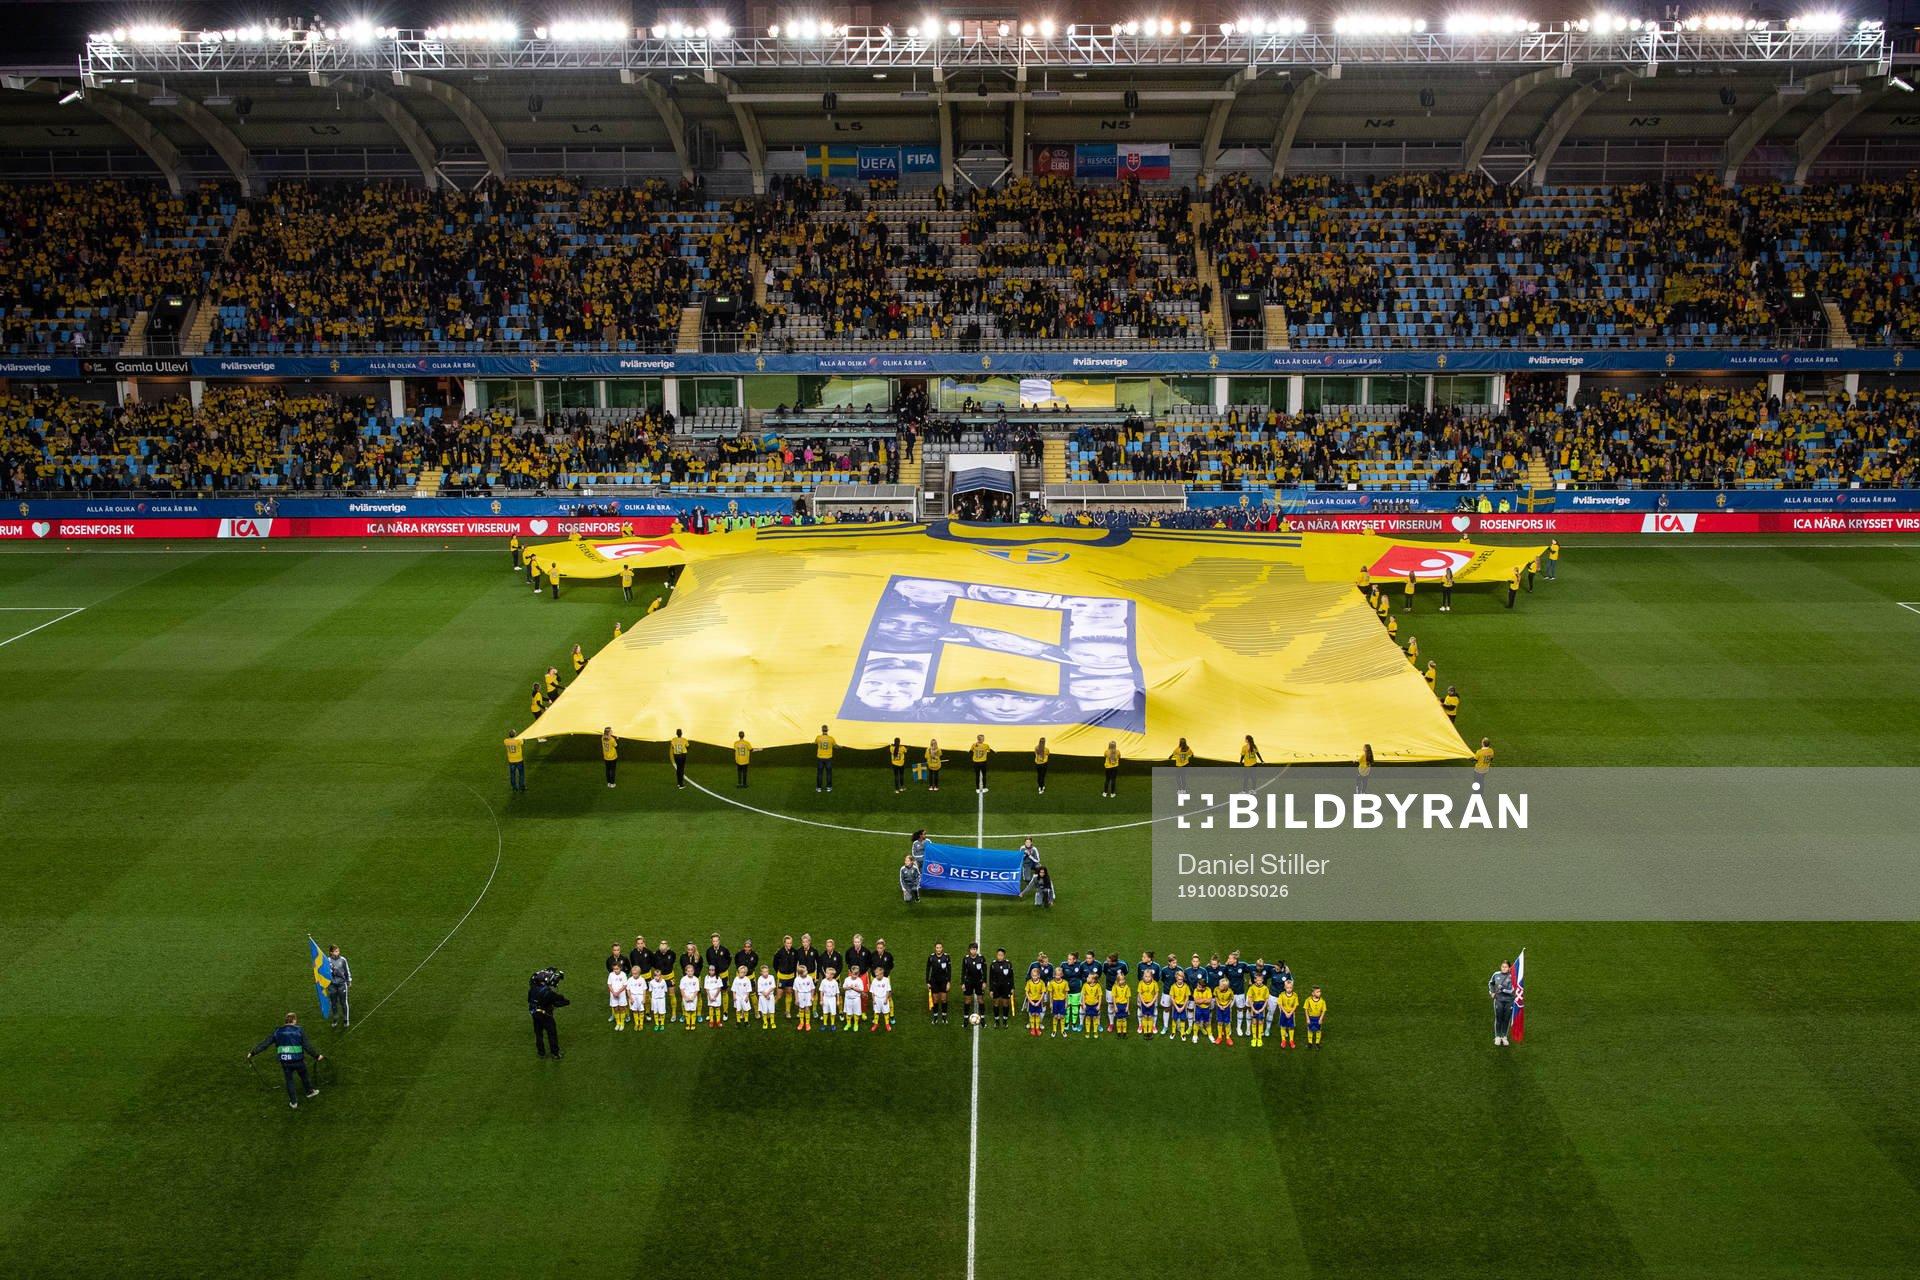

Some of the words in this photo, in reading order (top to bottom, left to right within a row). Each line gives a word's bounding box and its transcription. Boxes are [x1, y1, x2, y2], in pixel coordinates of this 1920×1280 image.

[834, 121, 863, 131] L5
[1101, 120, 1131, 129] N5
[1364, 119, 1395, 128] N4
[1629, 117, 1661, 127] N3
[46, 127, 80, 137] L2
[309, 126, 340, 135] L3
[572, 124, 602, 133] L4
[861, 158, 896, 169] UEFA
[907, 153, 935, 165] FIFA
[1087, 157, 1116, 166] RESPECT
[1050, 162, 1070, 170] EURO
[620, 359, 675, 370] #viärsverige
[837, 359, 846, 367] ÄR
[903, 358, 913, 366] ÄR
[1072, 357, 1128, 368] #viärsverige
[1291, 357, 1301, 365] ÄR
[1358, 357, 1368, 365] ÄR
[1528, 355, 1584, 366] #viärsverige
[0, 363, 51, 373] viärsverige
[115, 361, 153, 372] Gamla
[155, 361, 189, 372] Ullevi
[220, 361, 275, 372] #viärsverige
[1325, 497, 1335, 505] ÄR
[1572, 495, 1631, 507] #viärsverige
[1802, 496, 1812, 504] ÄR
[1872, 495, 1882, 503] ÄR
[104, 505, 114, 513] ÄR
[173, 504, 183, 512] ÄR
[349, 503, 407, 514] #viärsverige
[646, 502, 656, 511] ÄR
[367, 523, 385, 534] ICA
[387, 521, 419, 534] NÄRA
[420, 522, 465, 533] KRYSSET
[467, 522, 521, 533] VIRSERUM
[557, 522, 621, 533] ROSENFORS
[1287, 520, 1306, 531] CA
[1307, 518, 1340, 531] NÄRA
[1387, 519, 1442, 530] VIRSERUM
[1479, 519, 1544, 530] ROSENFORS
[1545, 519, 1556, 530] IK
[1655, 514, 1685, 532] ICA
[1793, 518, 1813, 529] ICA
[1814, 516, 1847, 529] NÄRA
[1848, 518, 1894, 529] KRYSSET
[1895, 518, 1920, 529] VIRS
[59, 524, 122, 535] ROSENFORS
[123, 524, 135, 535] IK
[231, 519, 260, 537] ICA
[949, 867, 1020, 881] RESPECT
